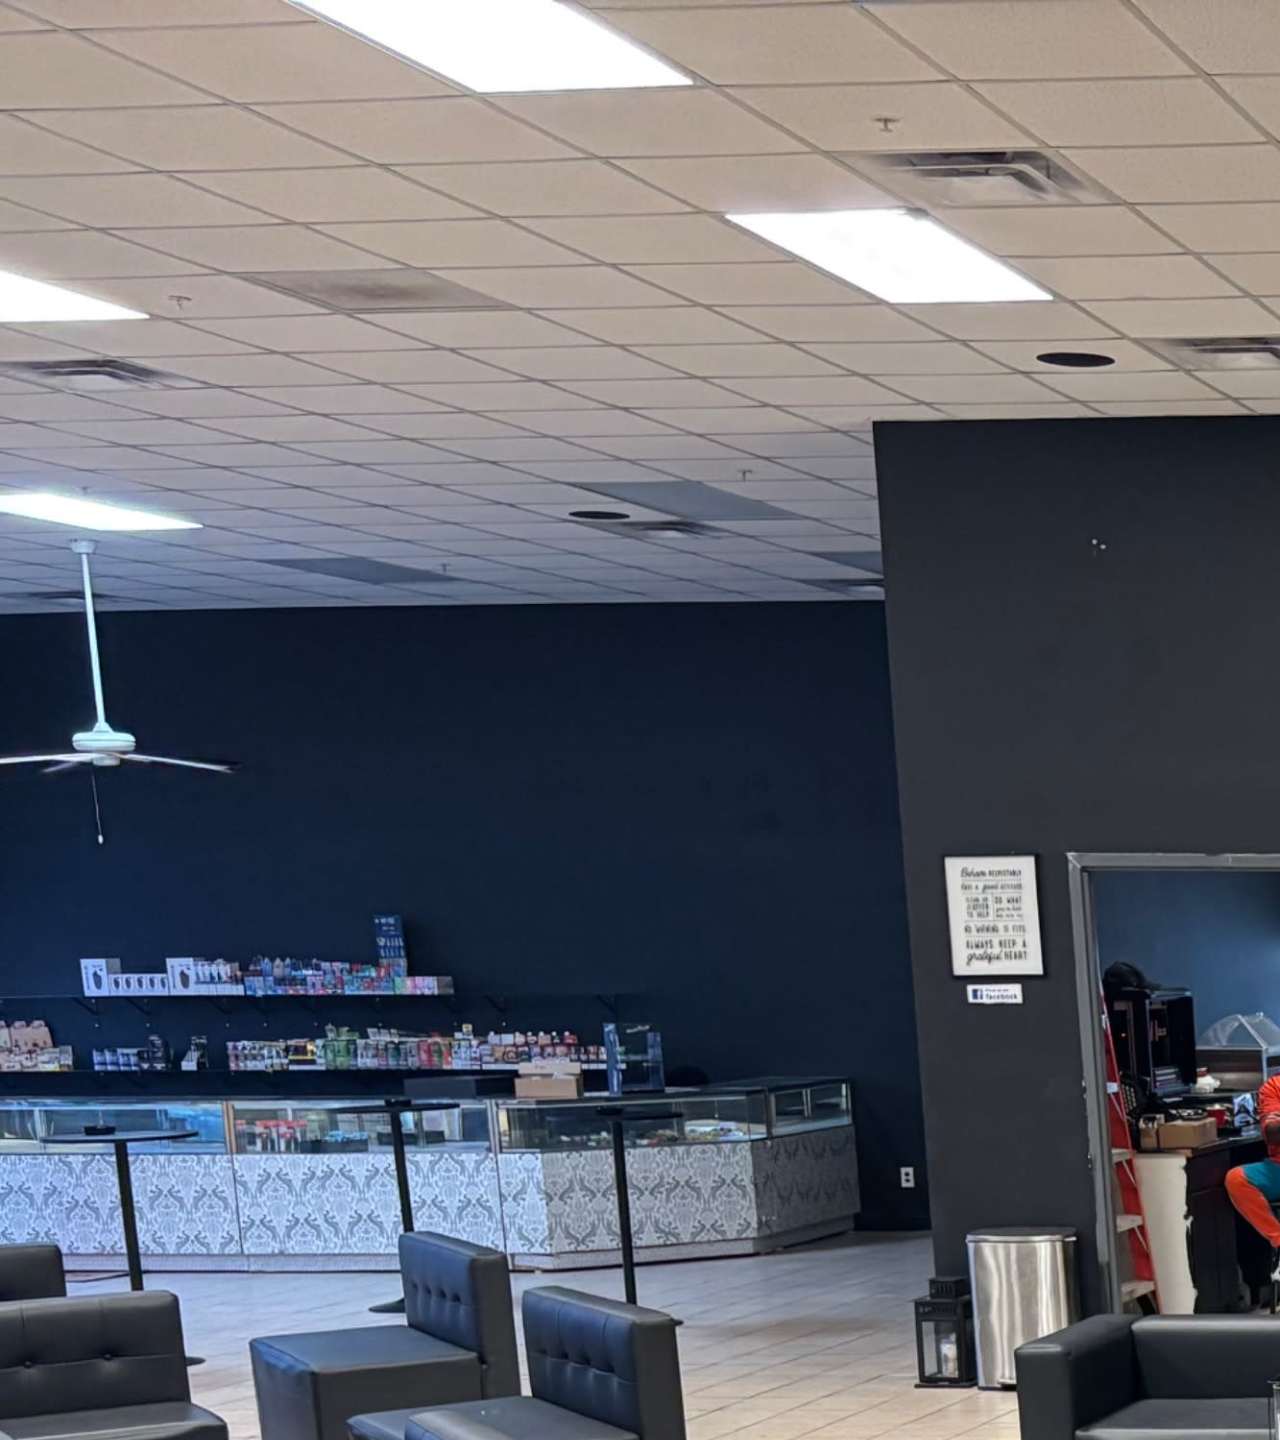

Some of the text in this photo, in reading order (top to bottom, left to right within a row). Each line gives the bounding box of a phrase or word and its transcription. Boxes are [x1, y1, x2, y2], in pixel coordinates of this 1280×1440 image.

[966, 938, 1027, 950] ALWAYS KEEP A
[966, 949, 1027, 966] grateful HEART
[985, 992, 1018, 1000] facebook
